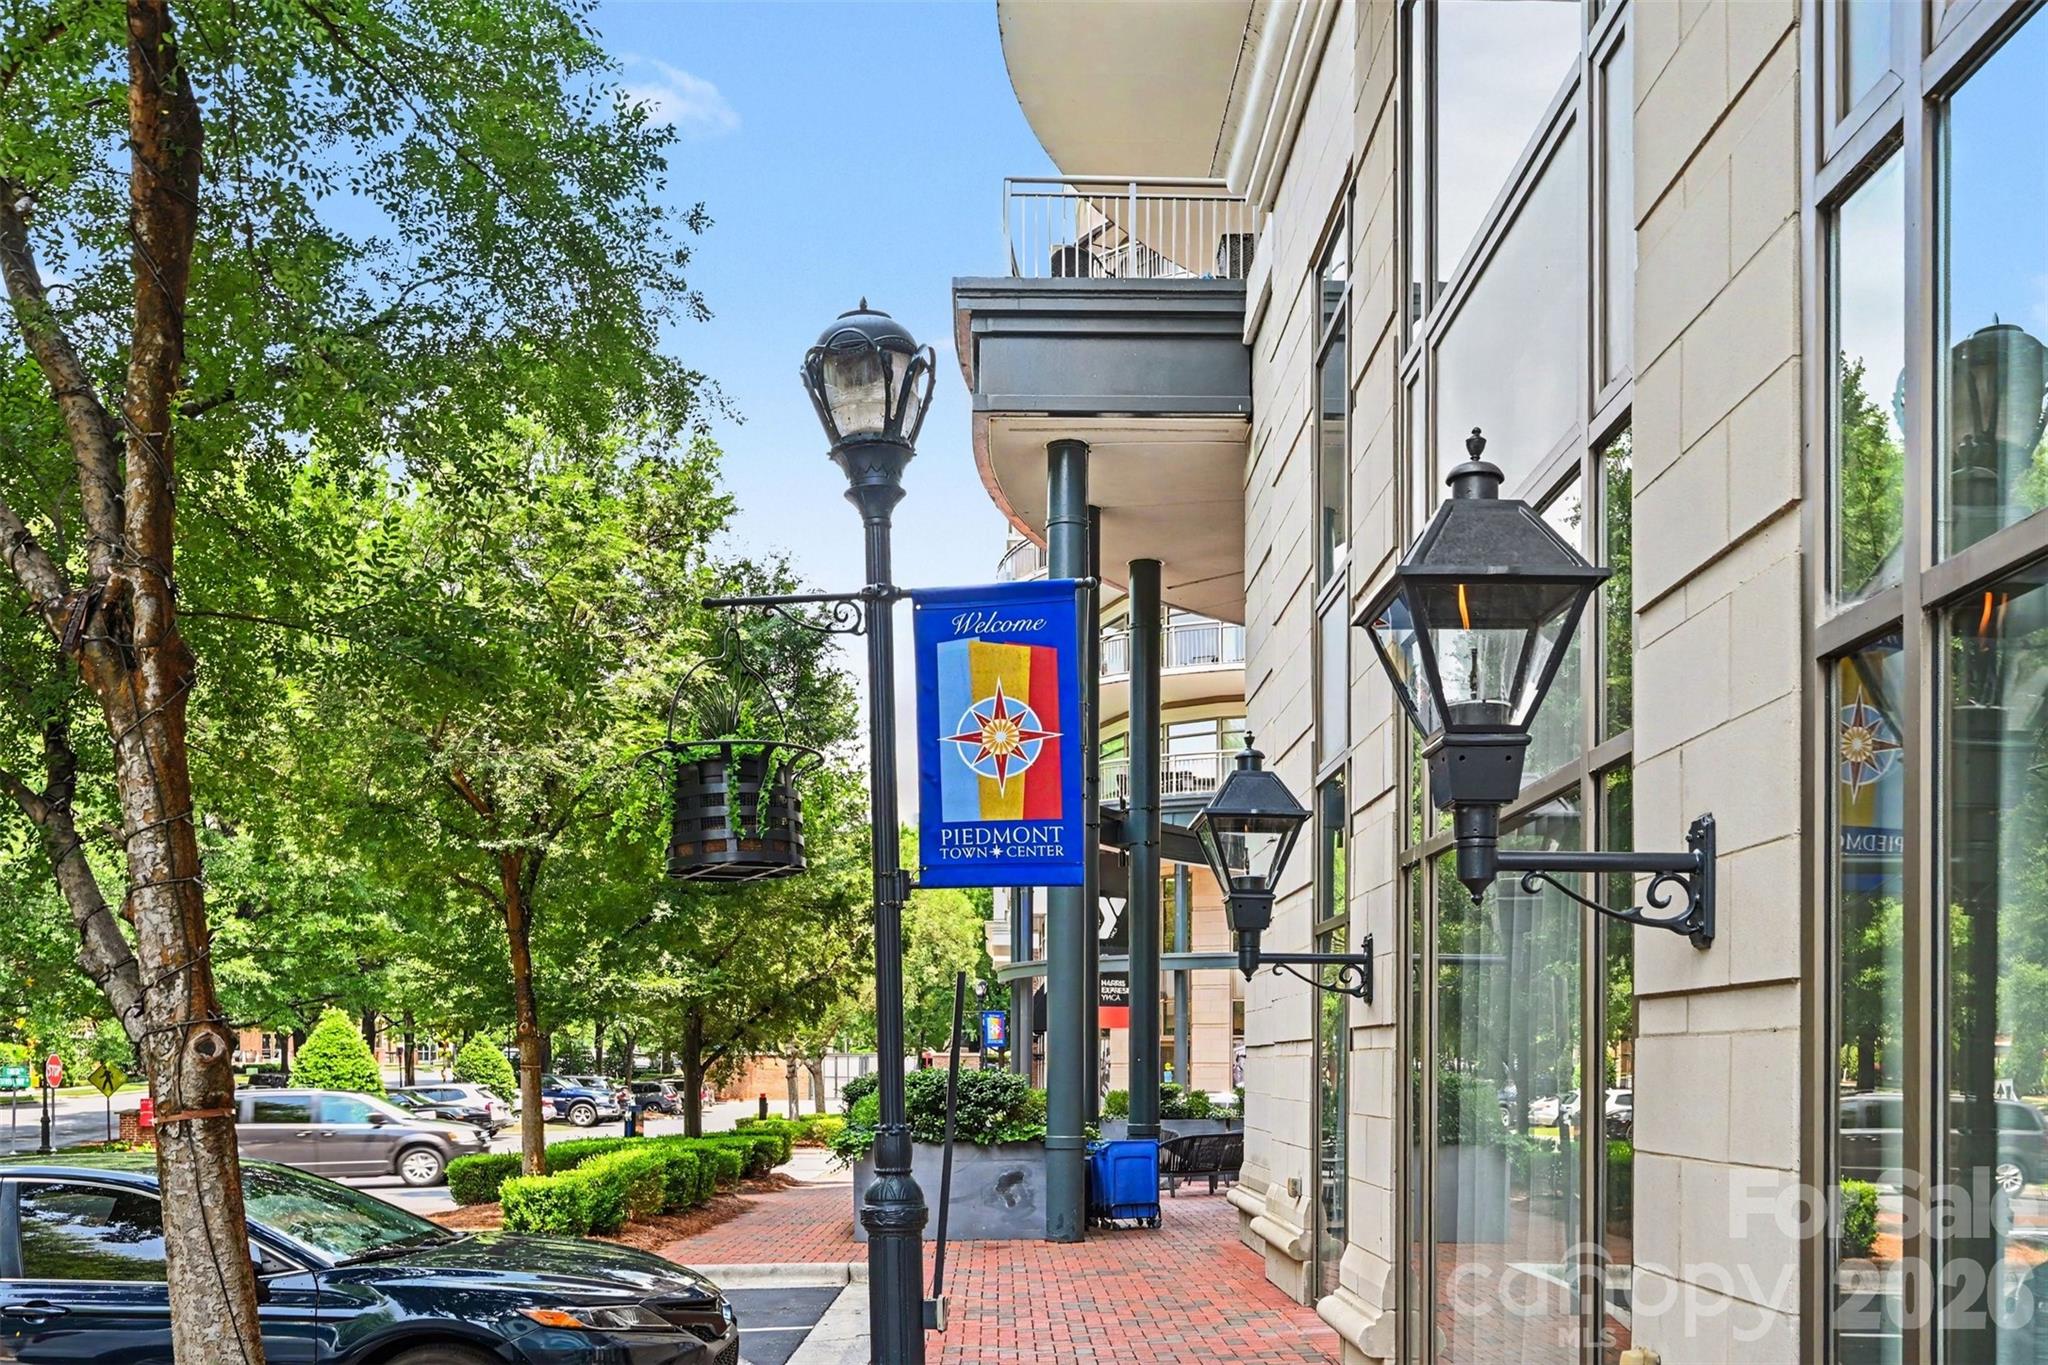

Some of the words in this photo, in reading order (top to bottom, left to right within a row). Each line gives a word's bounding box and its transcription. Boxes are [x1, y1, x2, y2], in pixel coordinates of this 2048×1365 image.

[951, 610, 1047, 636] Welcome
[940, 826, 1064, 846] PIEDMONT
[939, 846, 988, 860] TOWN
[1006, 845, 1064, 858] CENTER
[1101, 979, 1126, 987] HARRIS
[1101, 994, 1122, 1002] YMCA
